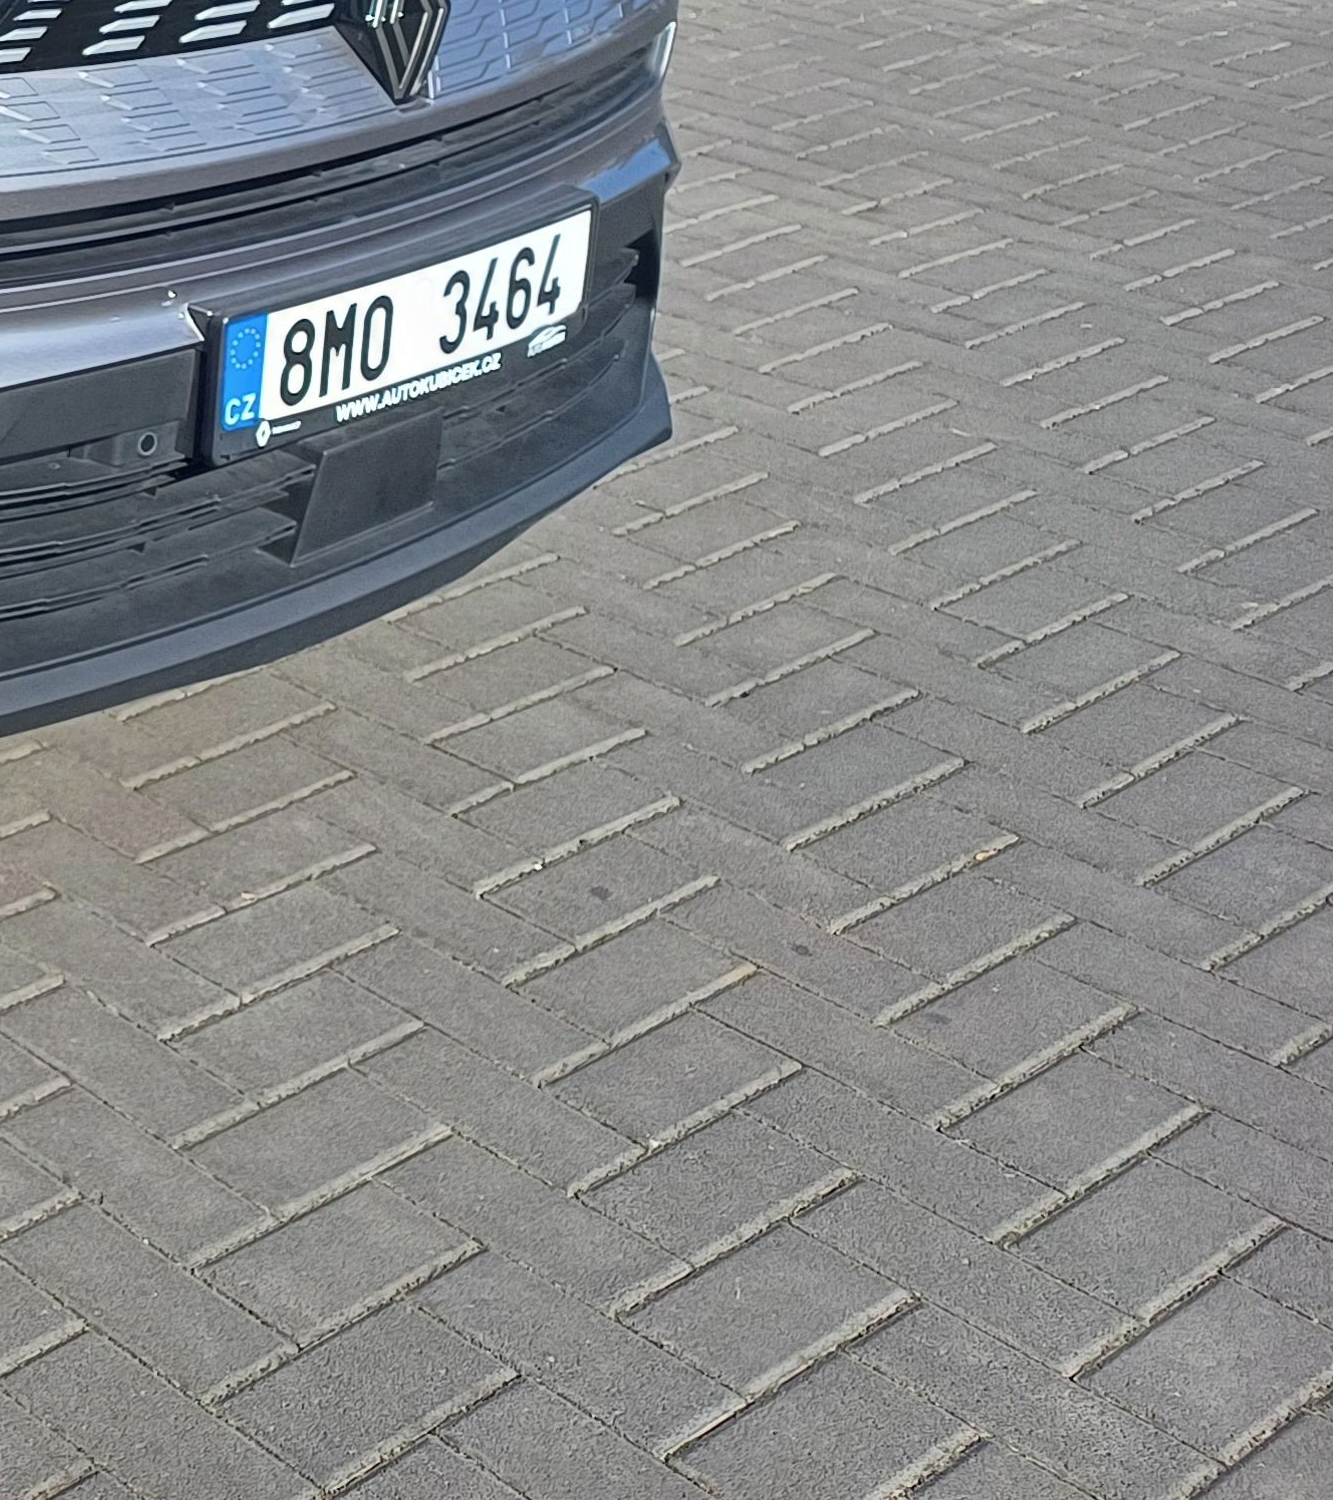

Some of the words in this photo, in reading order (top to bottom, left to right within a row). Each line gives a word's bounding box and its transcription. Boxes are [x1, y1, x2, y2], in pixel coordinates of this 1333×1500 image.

[439, 233, 562, 355] 3464
[224, 393, 256, 426] CZ
[335, 352, 502, 423] WWW.AUTOKUBICEK.CZ
